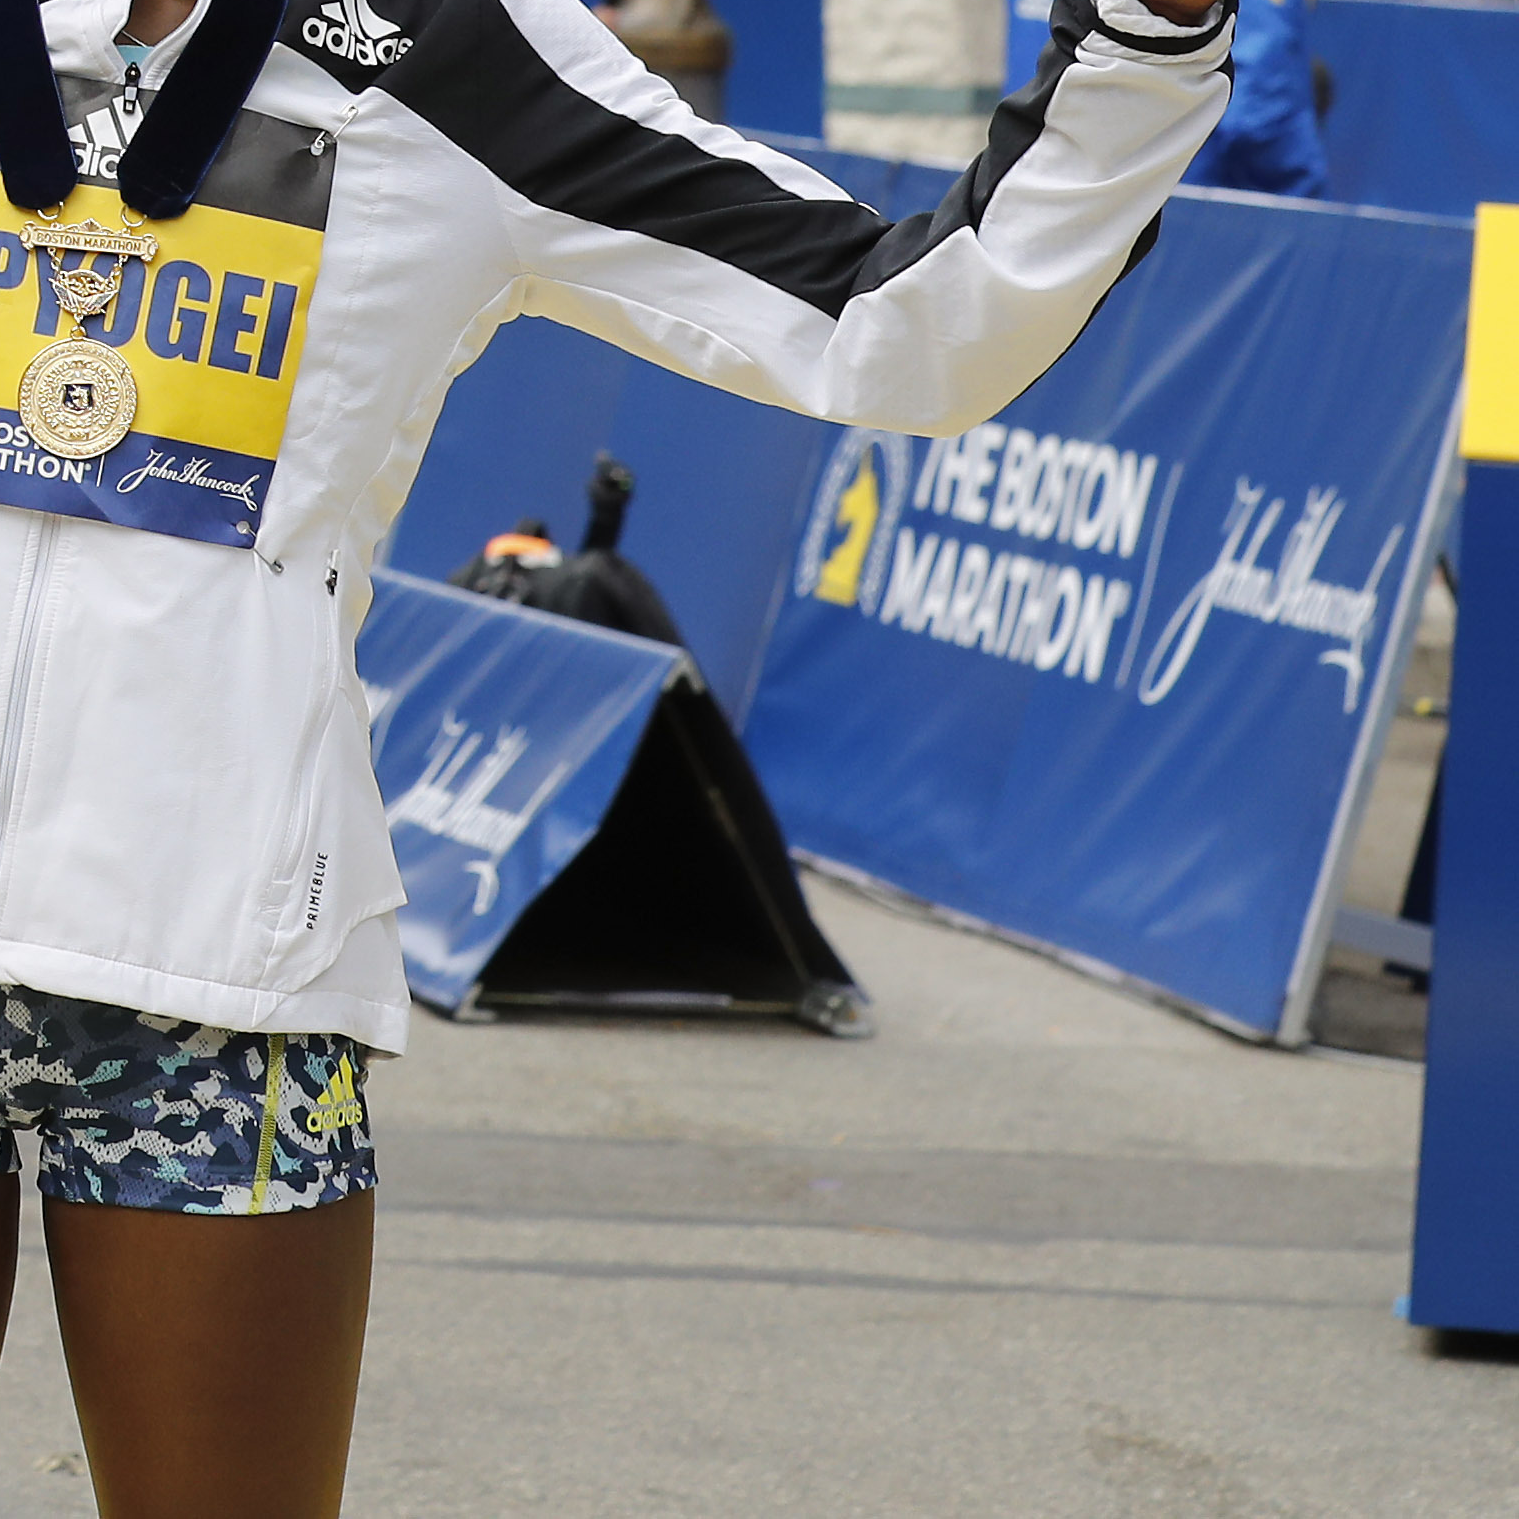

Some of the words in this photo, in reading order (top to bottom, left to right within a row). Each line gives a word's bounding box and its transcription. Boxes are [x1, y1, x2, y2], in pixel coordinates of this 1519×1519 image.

[302, 17, 414, 66] adidas
[36, 231, 80, 247] BOSTON
[83, 236, 142, 253] MARATHON
[116, 448, 179, 494] John
[177, 456, 261, 512] Hancock
[913, 422, 1008, 525] THE
[989, 427, 1158, 559] BOSTON
[878, 526, 1118, 683] MARATHON
[306, 851, 329, 930] PRIMEBLUE
[306, 1102, 363, 1133] adidas
